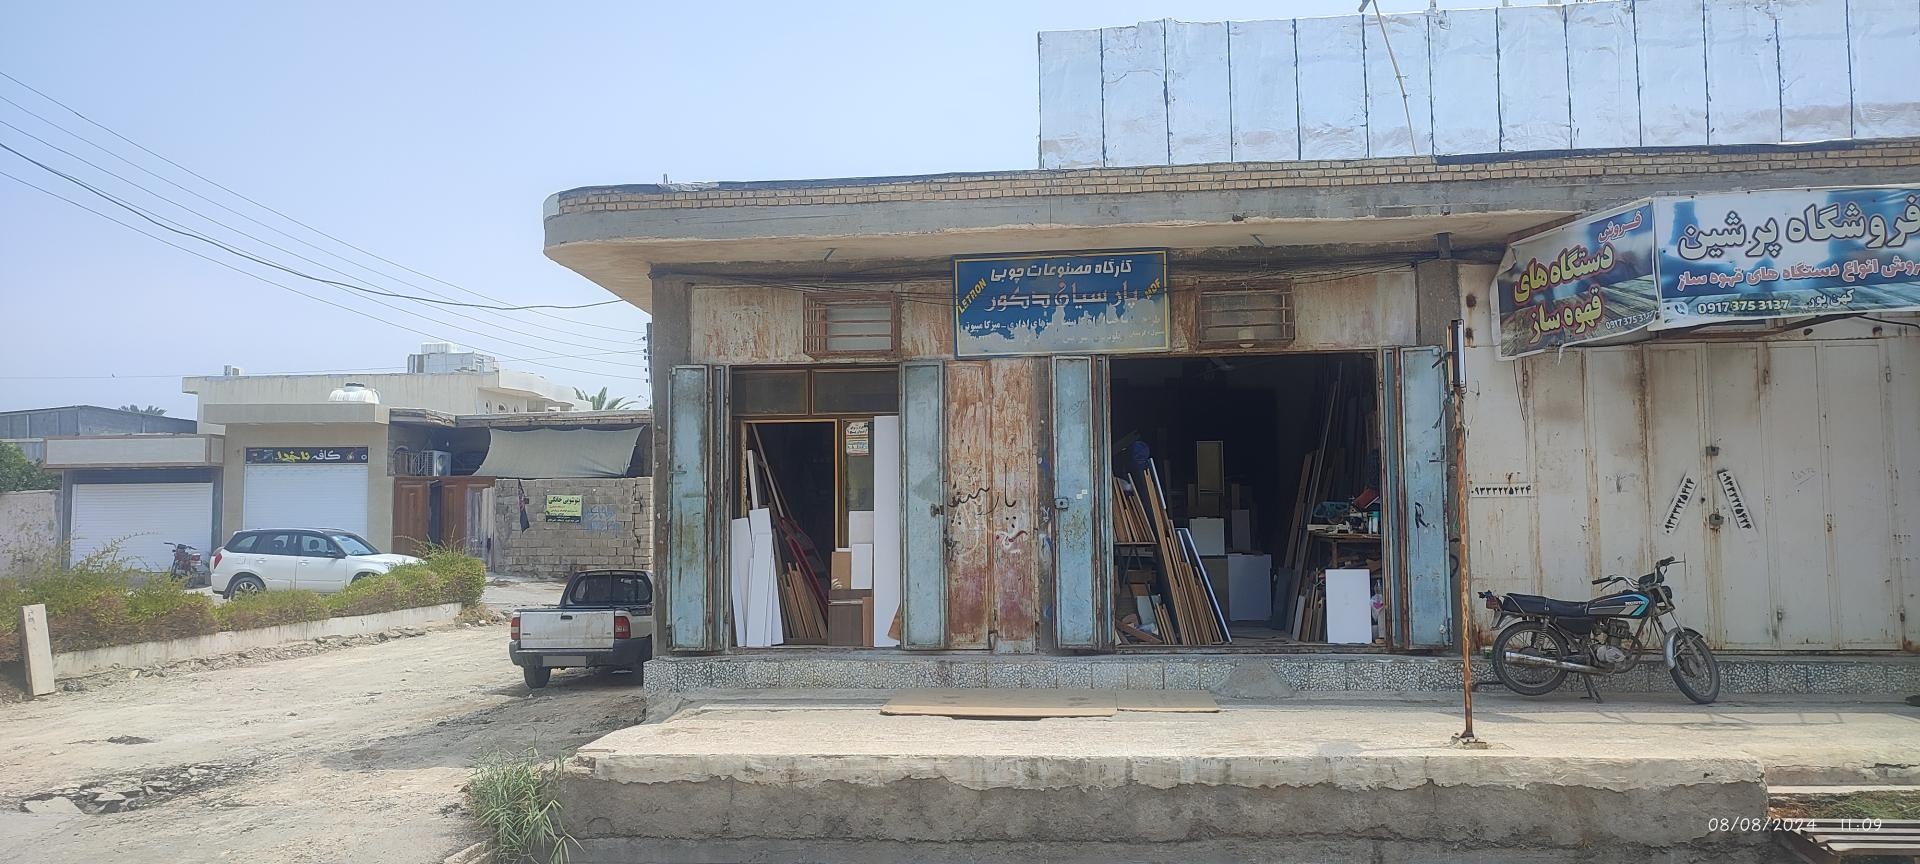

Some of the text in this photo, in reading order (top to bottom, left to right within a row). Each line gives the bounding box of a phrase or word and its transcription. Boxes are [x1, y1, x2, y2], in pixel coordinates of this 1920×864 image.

[1599, 211, 1643, 243] فروش
[1678, 194, 1920, 260] فروشگاه پرشین
[990, 259, 1133, 282] کارگاه مصنوعات چوبی
[1513, 244, 1615, 303] دستگاه های
[1677, 255, 1920, 291] روش انواع دستگاه های قهوه ساز
[1529, 287, 1602, 344] قهوه ساز
[1697, 299, 1790, 314] 0917 375 3137
[311, 449, 341, 461] کافه
